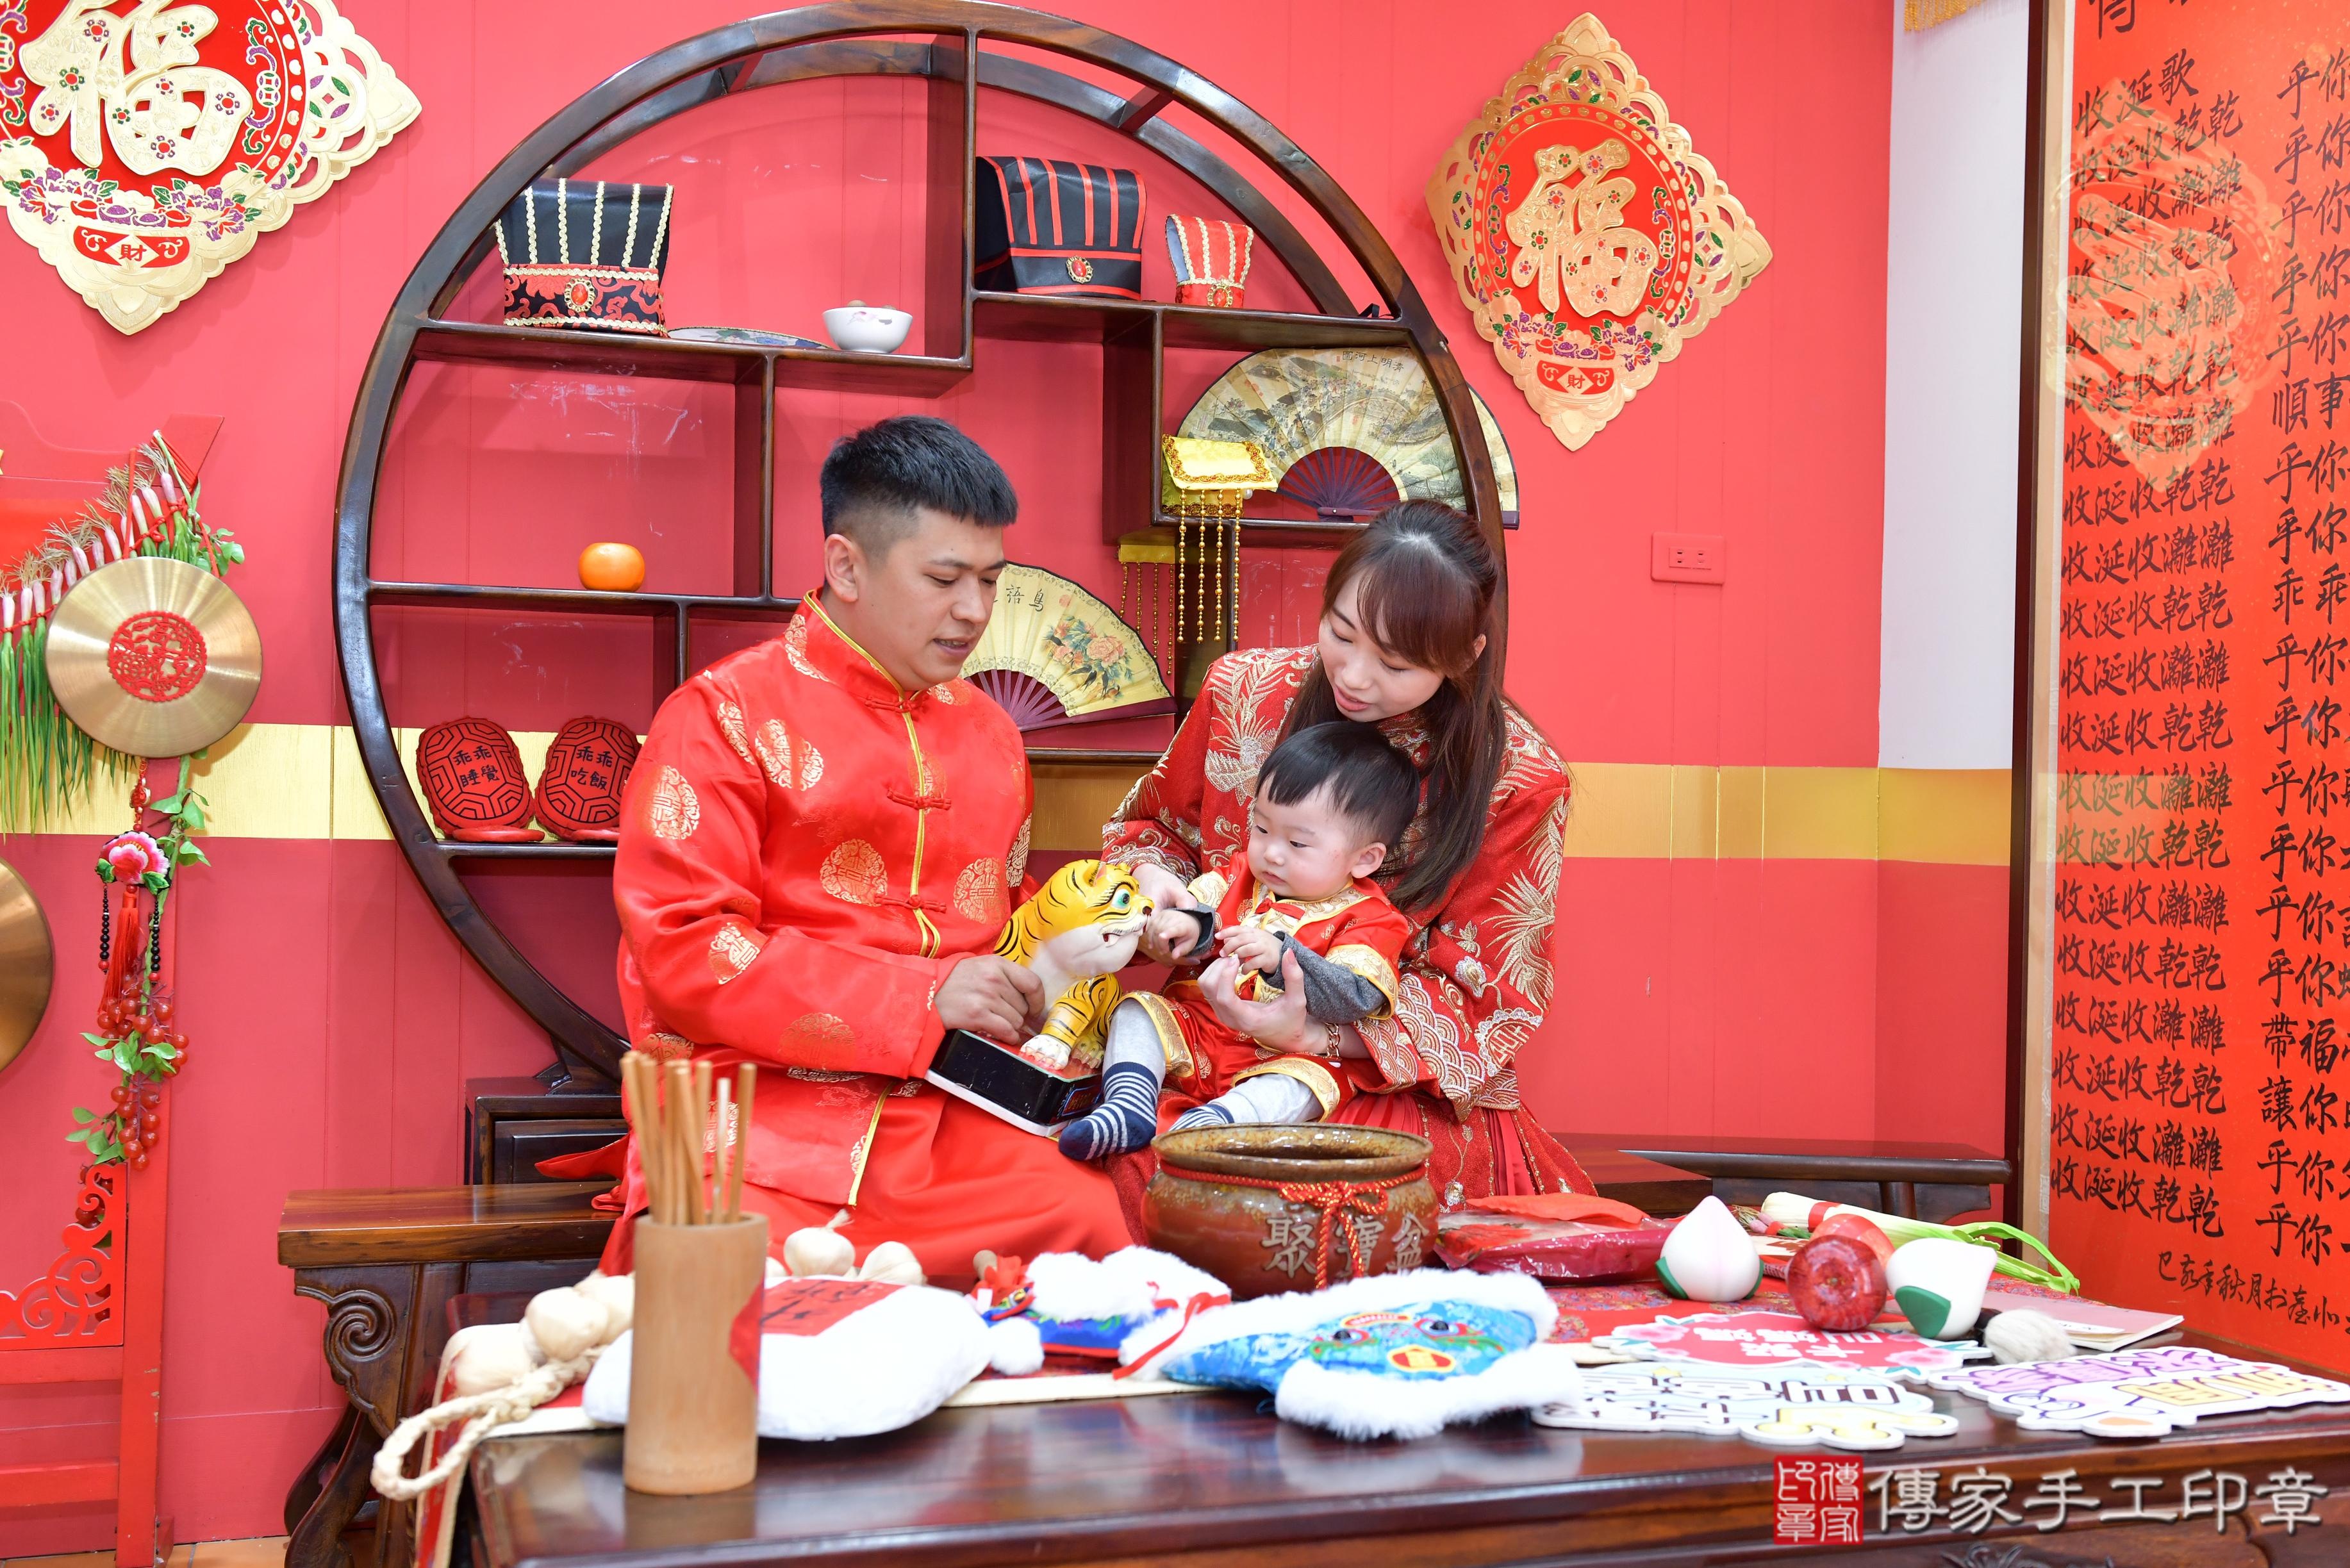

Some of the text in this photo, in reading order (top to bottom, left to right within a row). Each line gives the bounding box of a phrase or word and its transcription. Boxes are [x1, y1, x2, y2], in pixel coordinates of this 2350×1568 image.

[19, 0, 252, 176] 福
[2076, 48, 2199, 137] 收涎歌
[1505, 137, 1660, 317] 福
[119, 242, 146, 263] 財
[1567, 374, 1585, 390] 財
[452, 745, 492, 766] 乖乖
[575, 745, 613, 768] 乖乖
[459, 764, 499, 788] 睡覺
[570, 769, 608, 791] 吃飯
